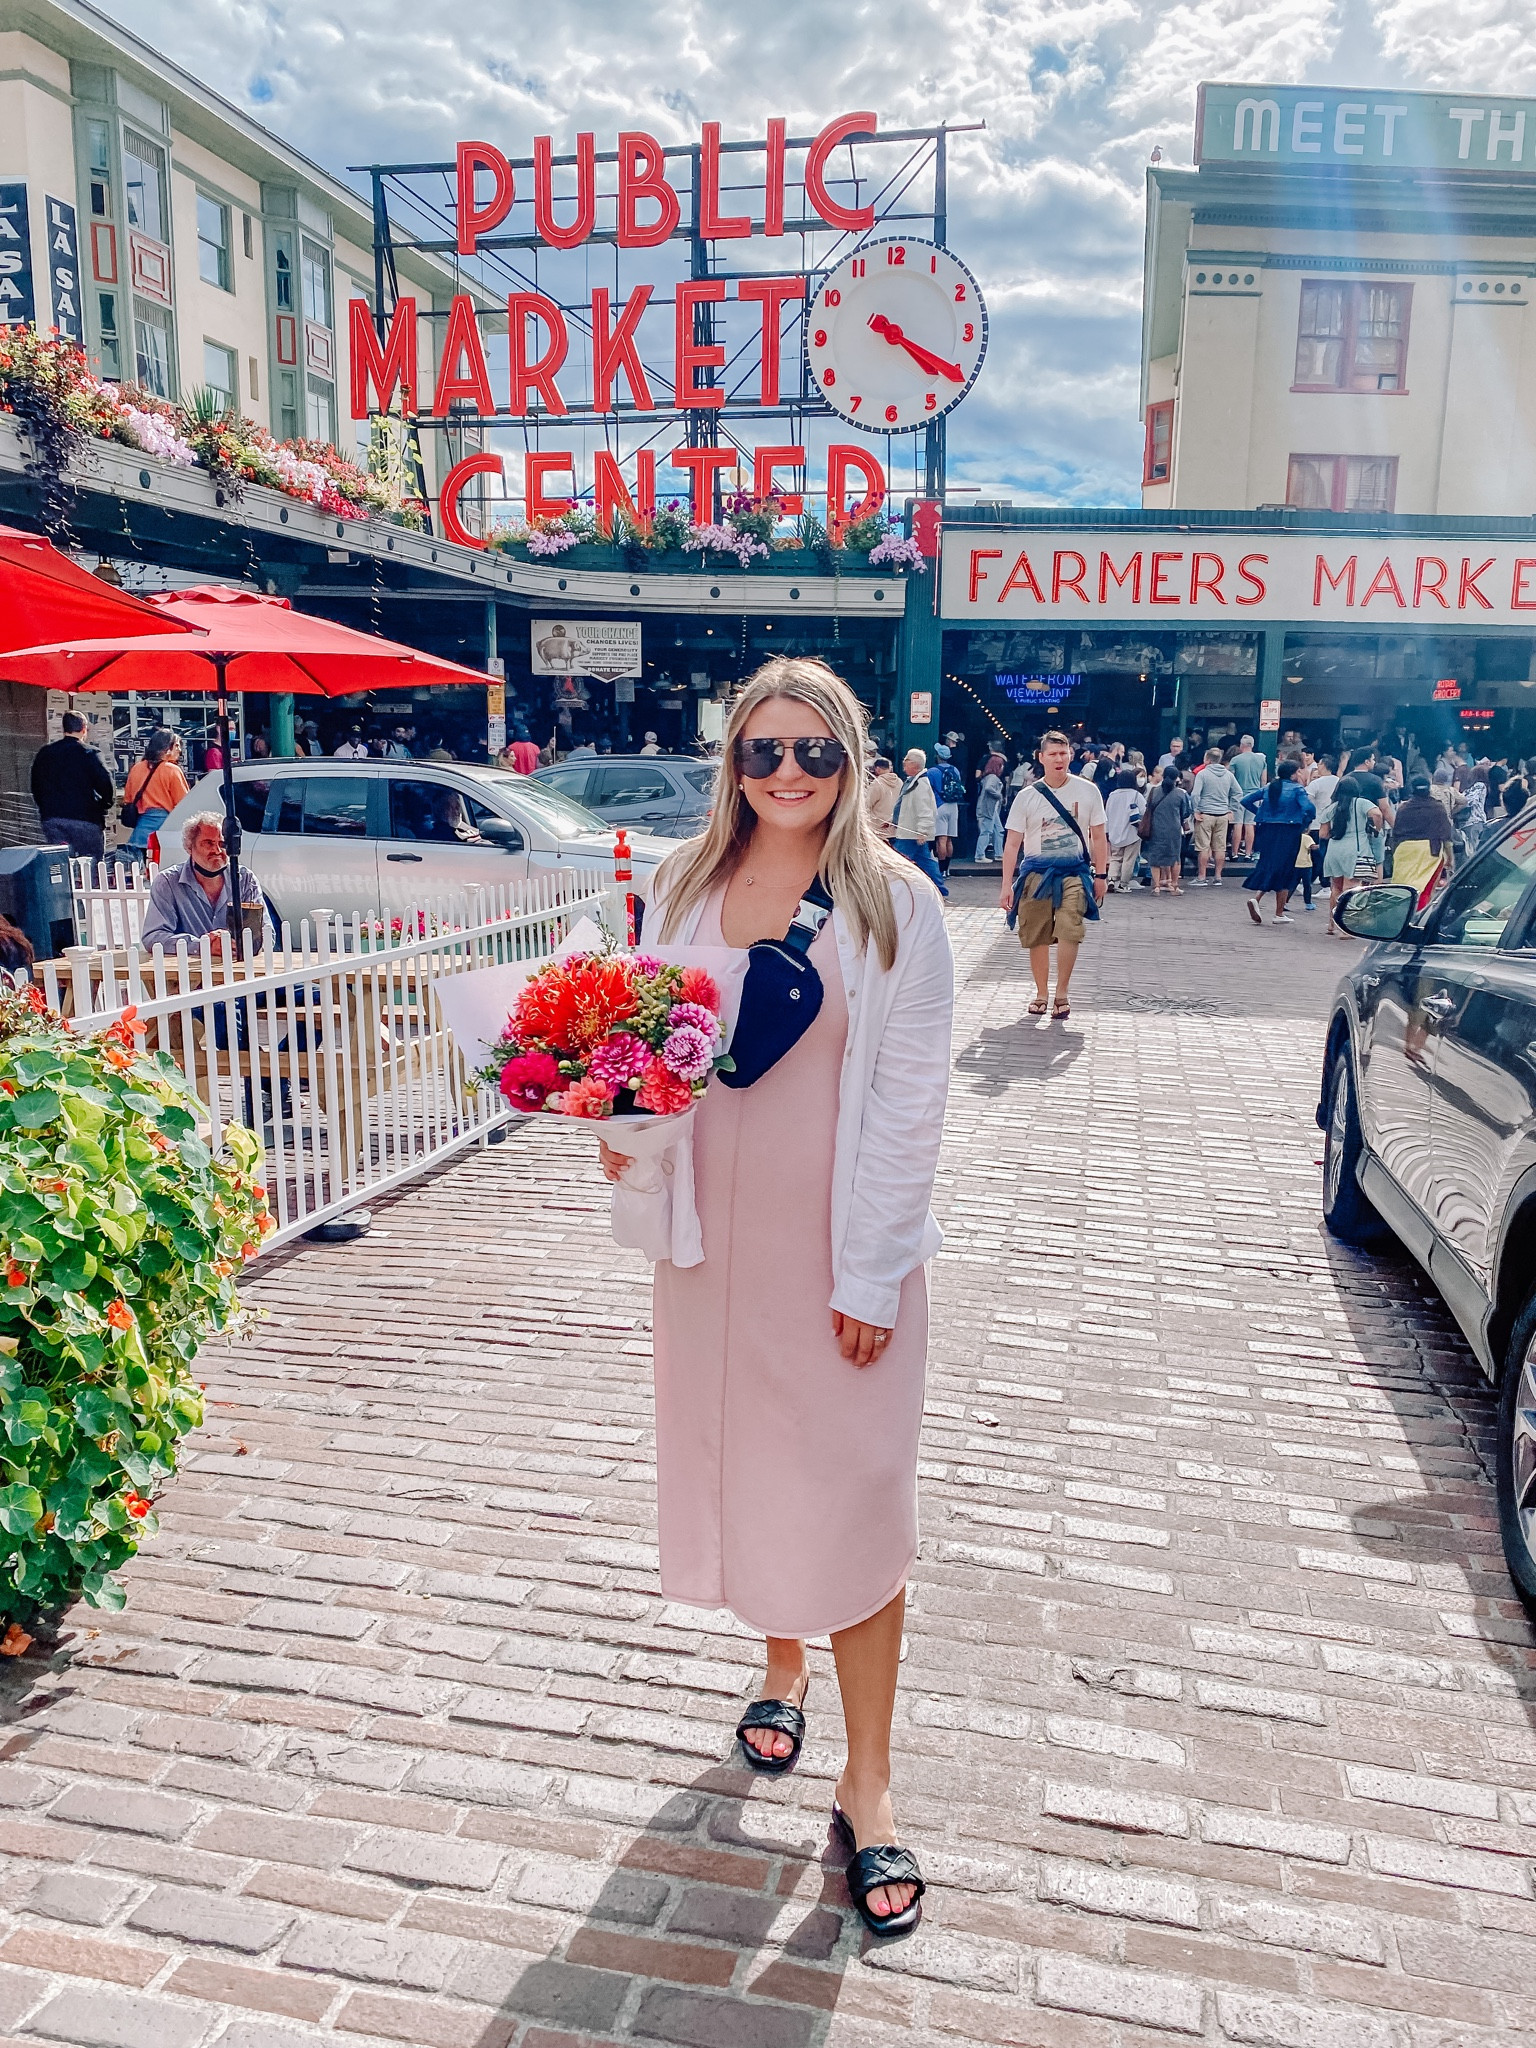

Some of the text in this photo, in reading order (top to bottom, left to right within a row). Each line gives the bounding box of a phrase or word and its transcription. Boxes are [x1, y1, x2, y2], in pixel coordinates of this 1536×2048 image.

[1233, 97, 1408, 156] MEET
[456, 110, 877, 256] PUBLIC
[51, 202, 74, 257] LA
[887, 246, 906, 265] 12
[930, 256, 936, 273] 1
[852, 259, 866, 278] 11
[824, 289, 841, 307] 10
[954, 284, 966, 301] 2
[814, 330, 828, 347] 9
[962, 323, 974, 342] 3
[349, 277, 807, 420] MARKET
[823, 368, 836, 386] 8
[850, 396, 862, 413] 7
[925, 394, 937, 410] 5
[885, 405, 898, 422] 6
[440, 444, 886, 550] CENTER
[968, 549, 1536, 611] FARMERS MARKE
[576, 626, 639, 639] YOUR CHANGE
[1006, 687, 1072, 698] VIEWPOINT
